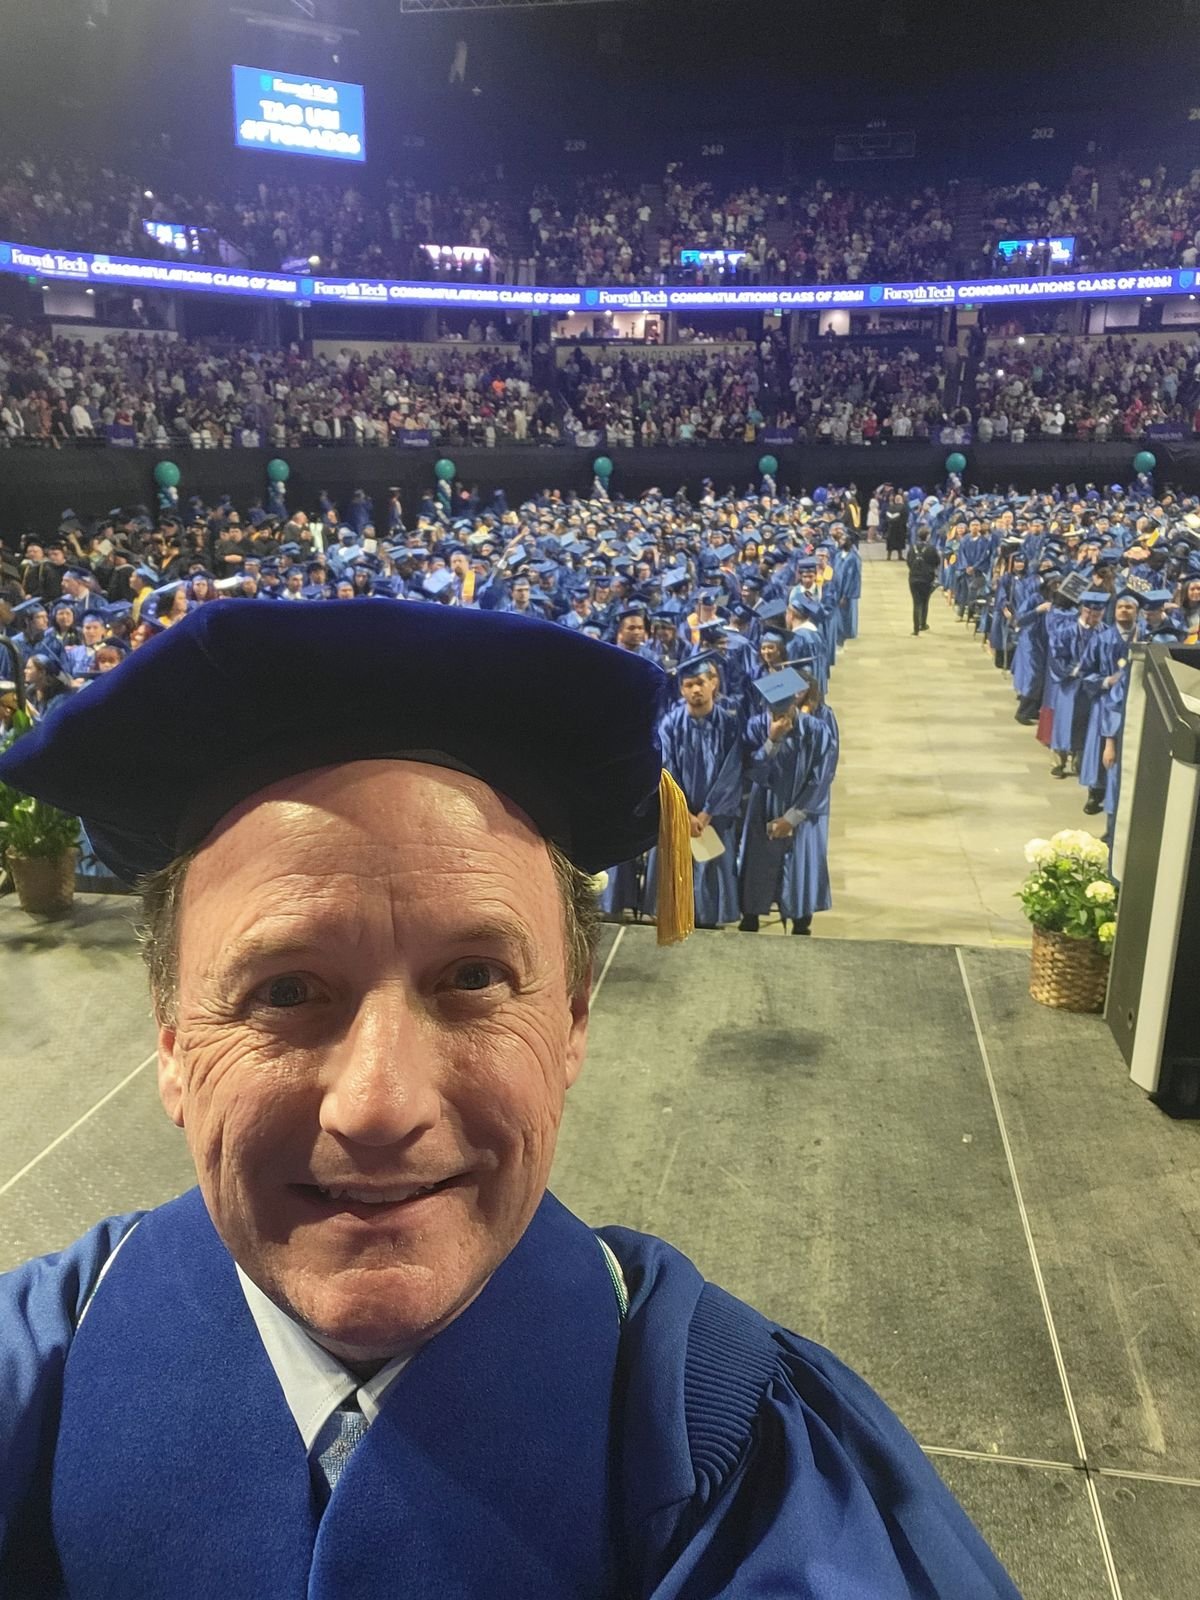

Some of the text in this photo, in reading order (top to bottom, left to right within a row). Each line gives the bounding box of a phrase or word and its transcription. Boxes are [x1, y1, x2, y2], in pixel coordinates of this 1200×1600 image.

[1032, 128, 1056, 139] 202
[11, 248, 55, 271] Forsyth
[55, 255, 89, 273] Tech
[314, 281, 359, 299] Forsyth
[359, 283, 388, 297] Tech
[600, 291, 641, 307] Forsyth
[641, 290, 668, 303] Tech
[670, 292, 778, 303] CONGRATULATIONS
[779, 291, 815, 303] CLASS
[815, 291, 832, 303] OF
[883, 285, 927, 302] Forsyth
[926, 285, 956, 298] Tech
[958, 280, 1075, 298] CONGRATULATIONS
[1077, 279, 1116, 291] CLASS
[1117, 277, 1137, 289] OF
